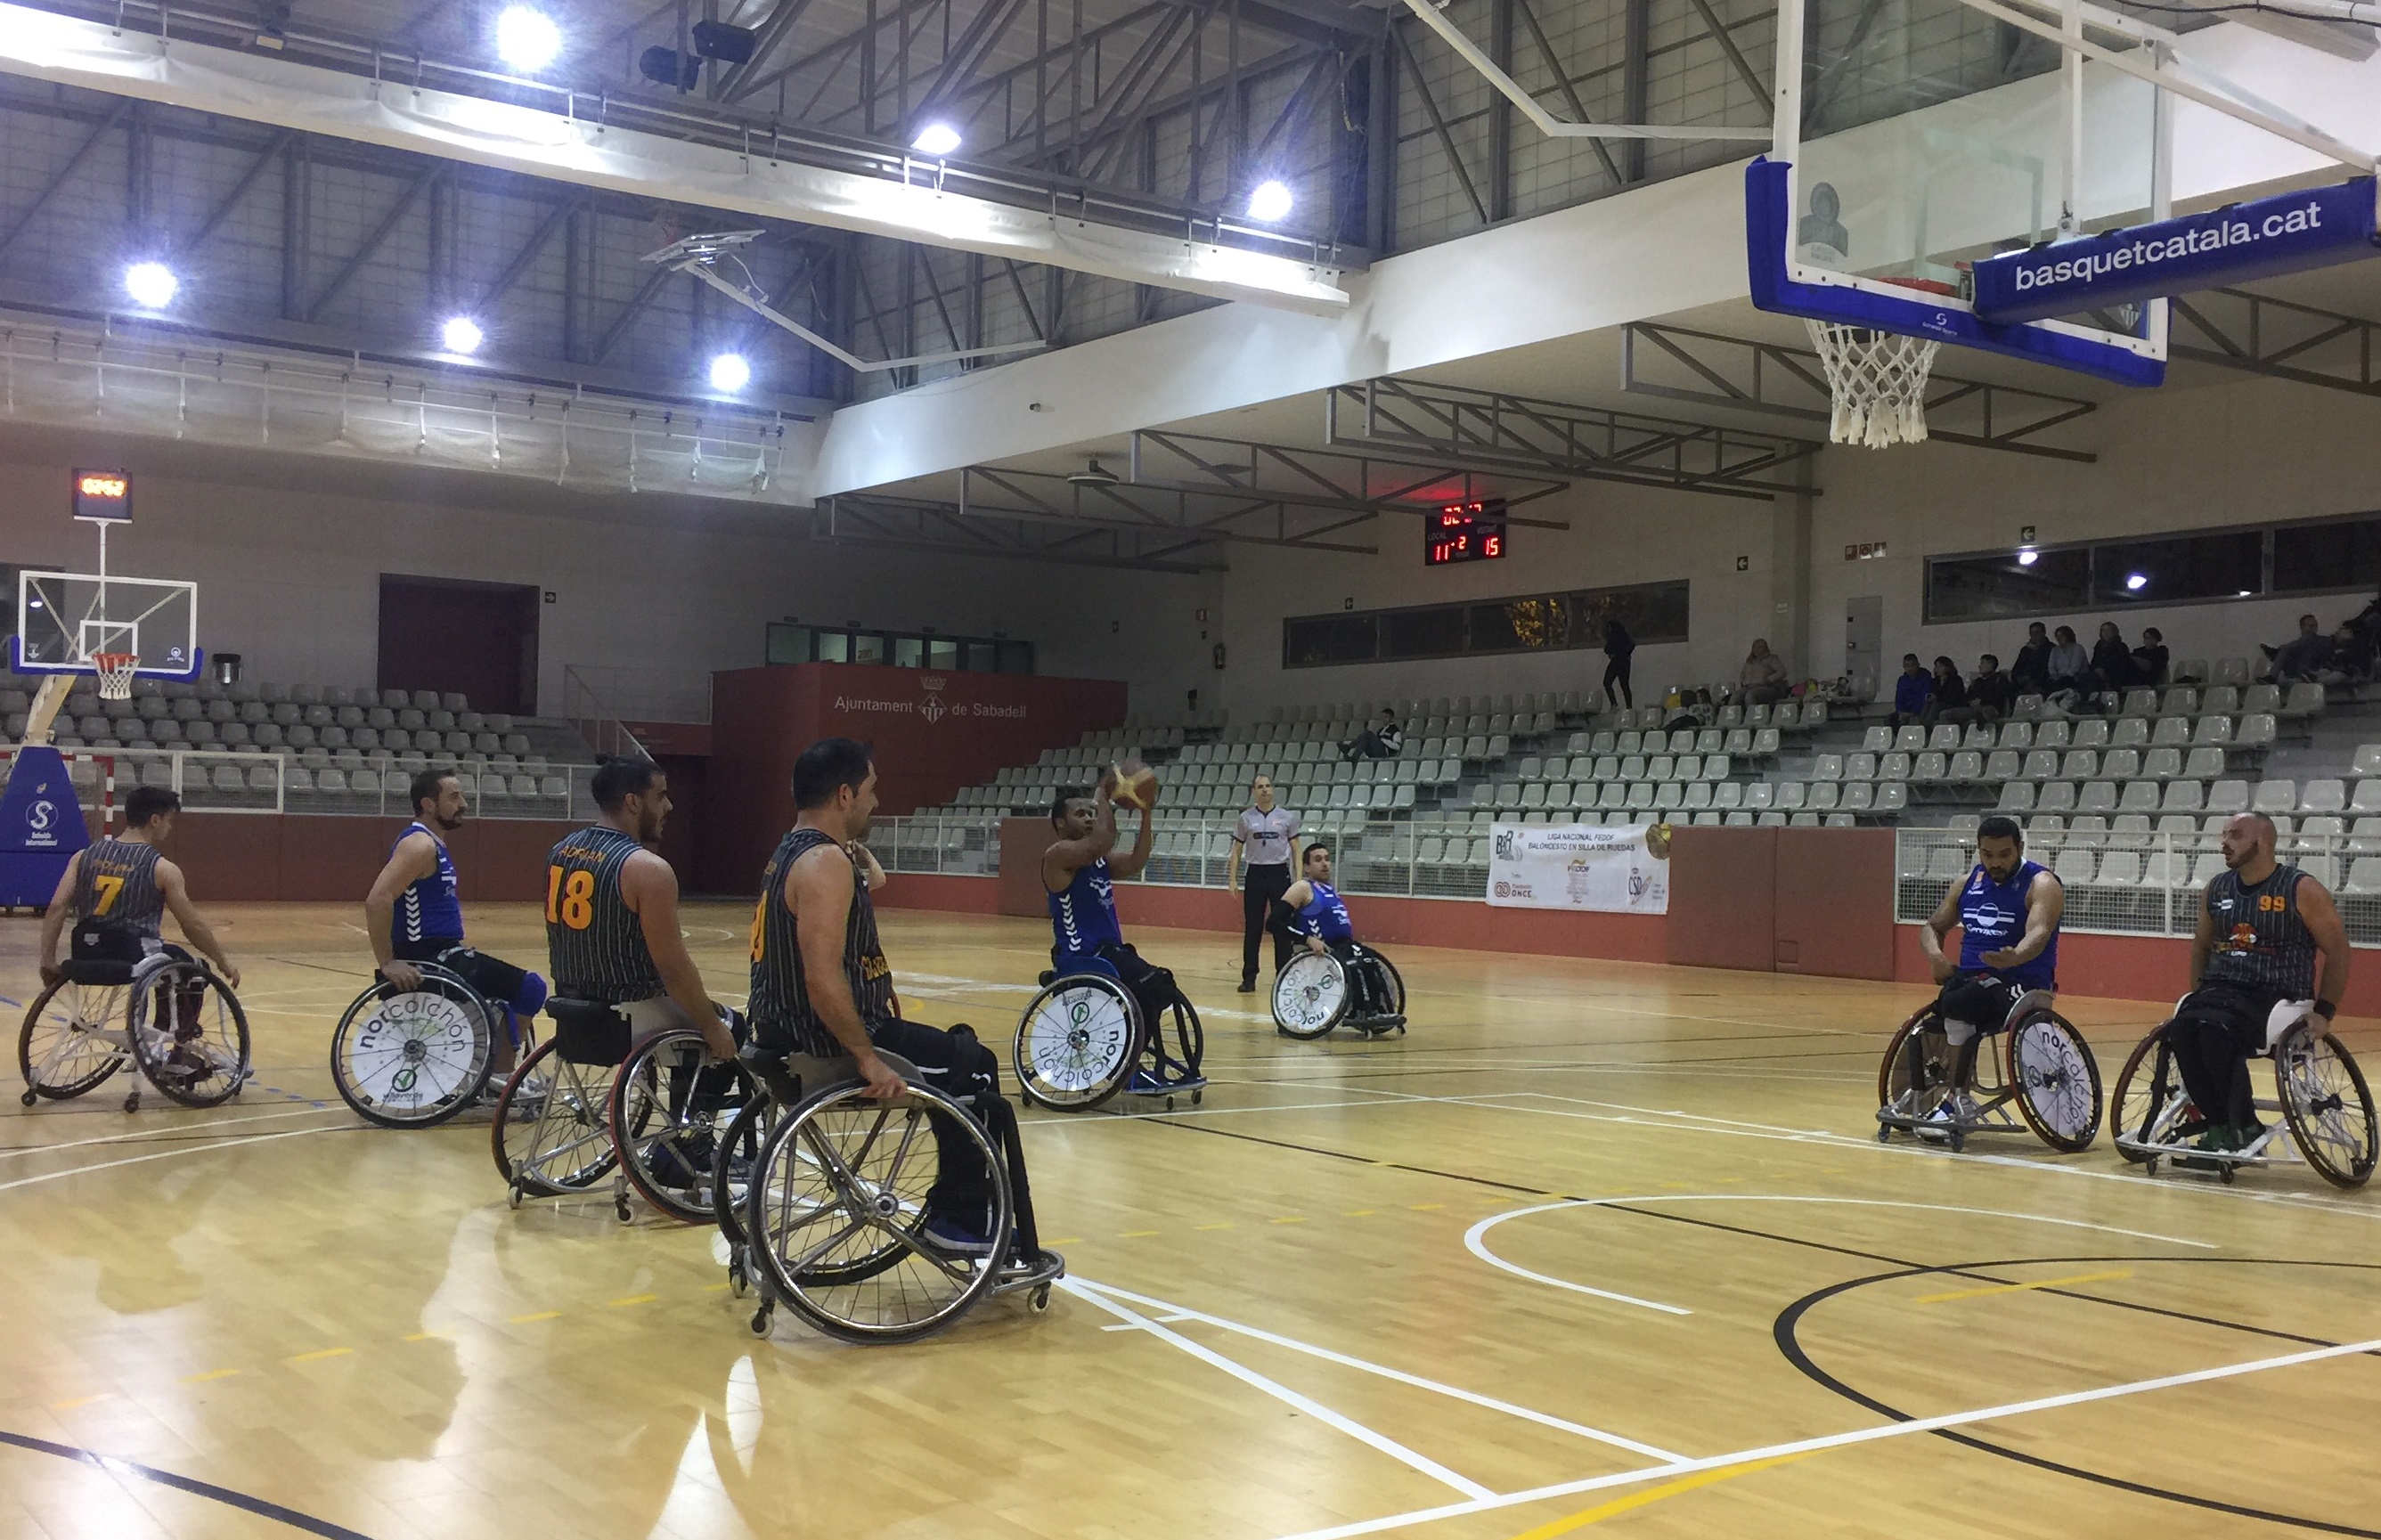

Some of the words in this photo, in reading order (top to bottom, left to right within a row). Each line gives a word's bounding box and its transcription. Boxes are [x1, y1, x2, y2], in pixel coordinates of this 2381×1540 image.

[2017, 201, 2321, 291] basquetcatala.cat
[1436, 544, 1449, 561] 11
[1486, 537, 1498, 555] 15
[835, 696, 913, 713] Ajuntament
[951, 704, 967, 716] de
[973, 703, 1026, 718] Sabadell
[1528, 842, 1567, 850] BALONCESTO
[1569, 843, 1578, 851] EN
[1578, 843, 1595, 851] SILLA
[1596, 843, 1605, 851] DE
[1607, 843, 1635, 851] RUEDAS
[93, 875, 125, 917] 7
[546, 864, 594, 930] 18
[1512, 890, 1532, 898] ONCE
[2259, 894, 2286, 912] 99
[360, 996, 469, 1052] norcolchón
